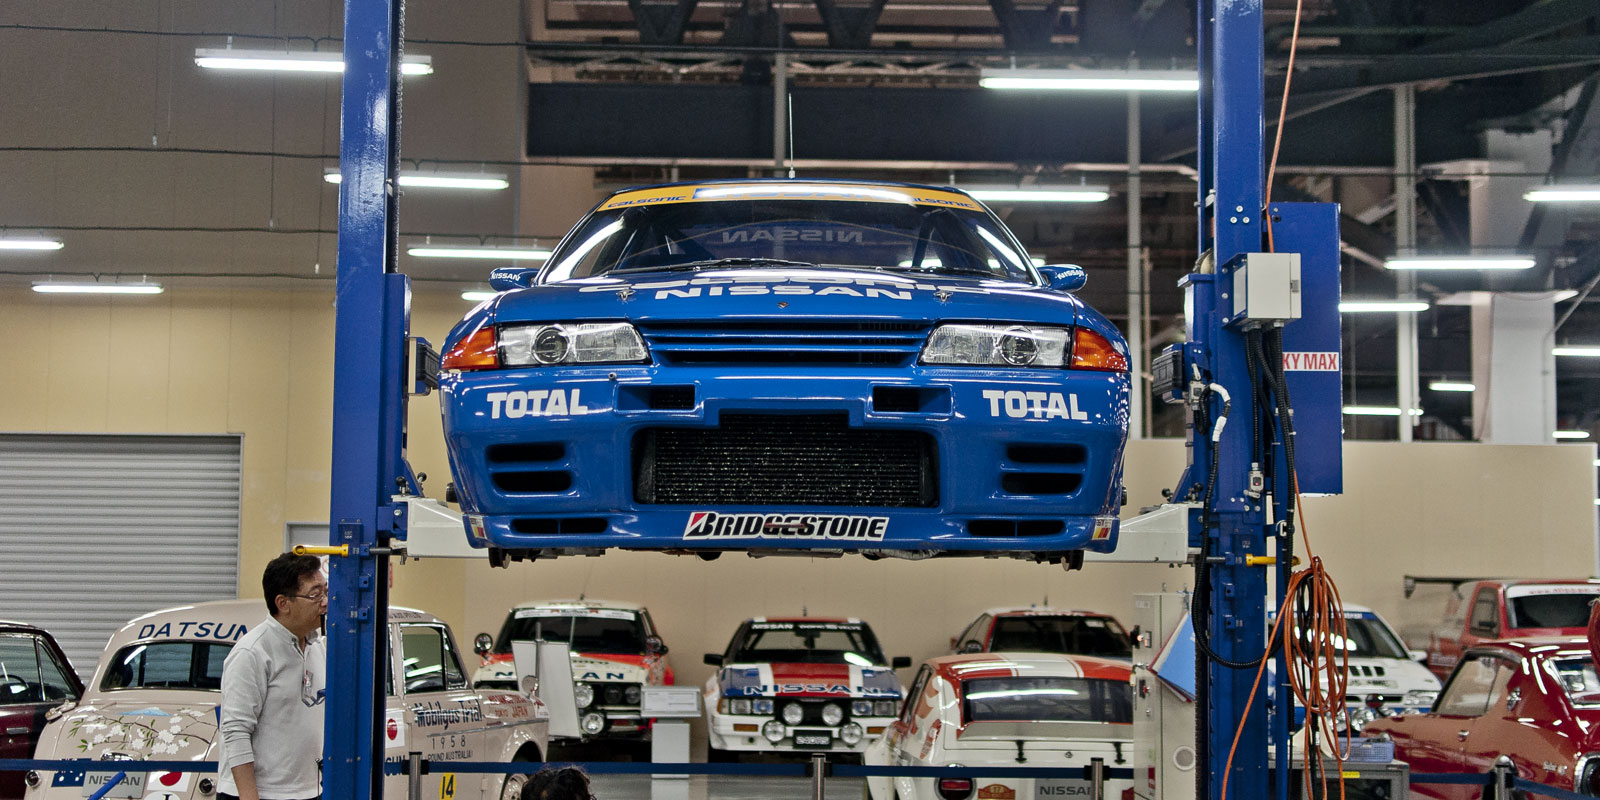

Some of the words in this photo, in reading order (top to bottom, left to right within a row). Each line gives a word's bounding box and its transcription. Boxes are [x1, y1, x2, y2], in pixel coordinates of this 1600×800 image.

[491, 272, 520, 281] NISSAN
[655, 285, 913, 300] NISSAN
[1303, 353, 1337, 370] MAX
[487, 388, 588, 419] TOTAL
[982, 389, 1088, 420] TOTAL
[685, 512, 887, 538] BRIDGESTONE
[744, 684, 880, 696] NISSAN
[88, 775, 141, 787] NISAN
[441, 774, 454, 799] 14
